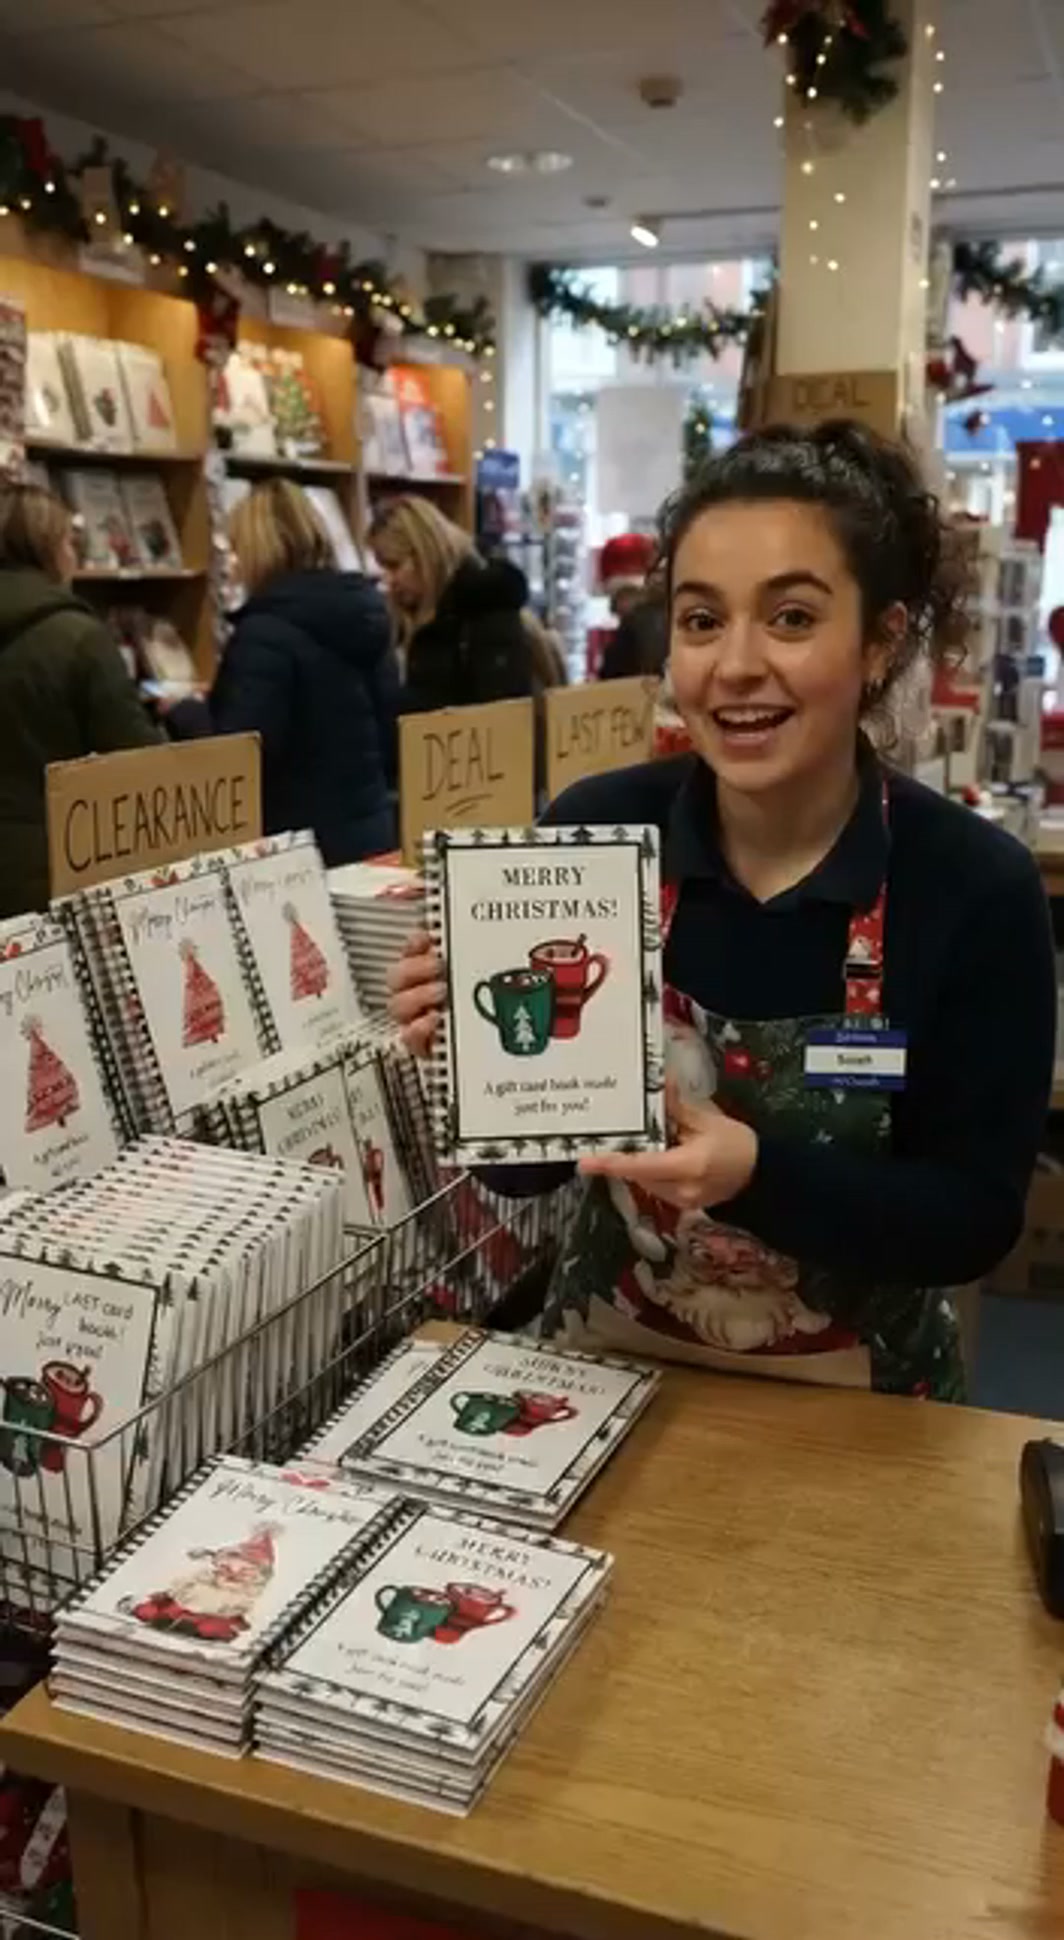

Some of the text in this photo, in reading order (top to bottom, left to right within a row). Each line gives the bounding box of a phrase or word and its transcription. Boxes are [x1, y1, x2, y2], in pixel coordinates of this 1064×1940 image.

[792, 377, 871, 412] DEAL
[556, 705, 651, 760] LAST FEW
[422, 727, 505, 800] DEAL
[65, 775, 248, 872] CLEARANCE
[502, 866, 586, 886] MERRY
[470, 899, 618, 921] CHRISTMAS!
[483, 1081, 494, 1096] A
[495, 1080, 518, 1098] gift
[520, 1079, 547, 1092] card
[583, 1075, 617, 1090] made
